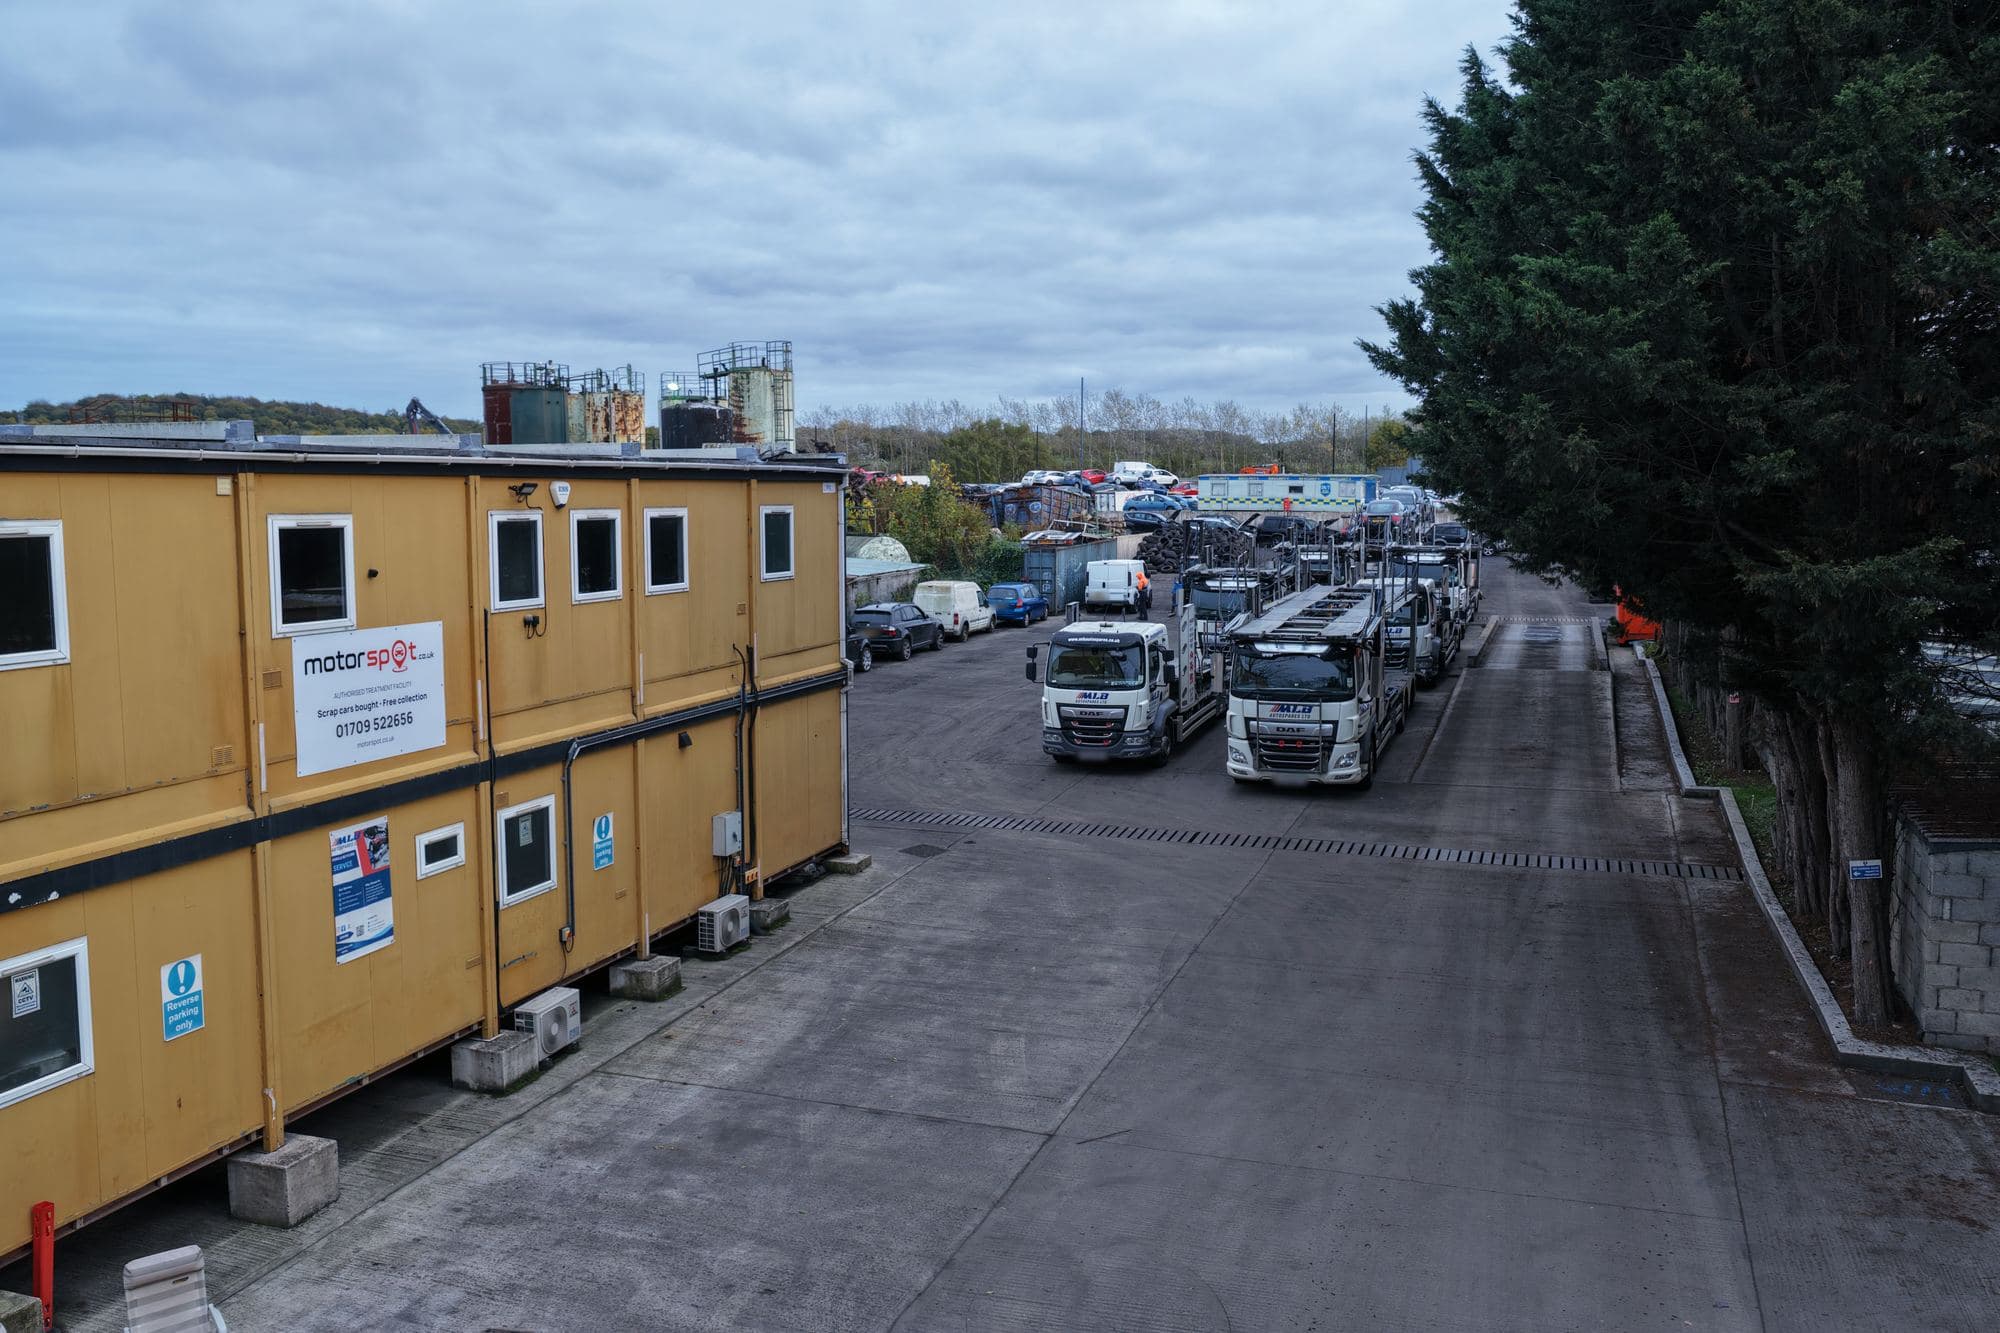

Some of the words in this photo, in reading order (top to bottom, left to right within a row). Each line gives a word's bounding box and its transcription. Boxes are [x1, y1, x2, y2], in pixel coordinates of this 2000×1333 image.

[317, 707, 339, 719] Scrap
[338, 704, 354, 715] cars
[354, 700, 379, 714] bought
[382, 698, 397, 708] Free
[397, 692, 427, 705] collection
[1280, 704, 1312, 713] MLB
[336, 719, 370, 738] 01709
[373, 711, 413, 730] 522656
[18, 994, 34, 1004] CCTV
[167, 994, 200, 1012] Reverse
[168, 1006, 199, 1025] parking
[175, 1019, 193, 1032] only
